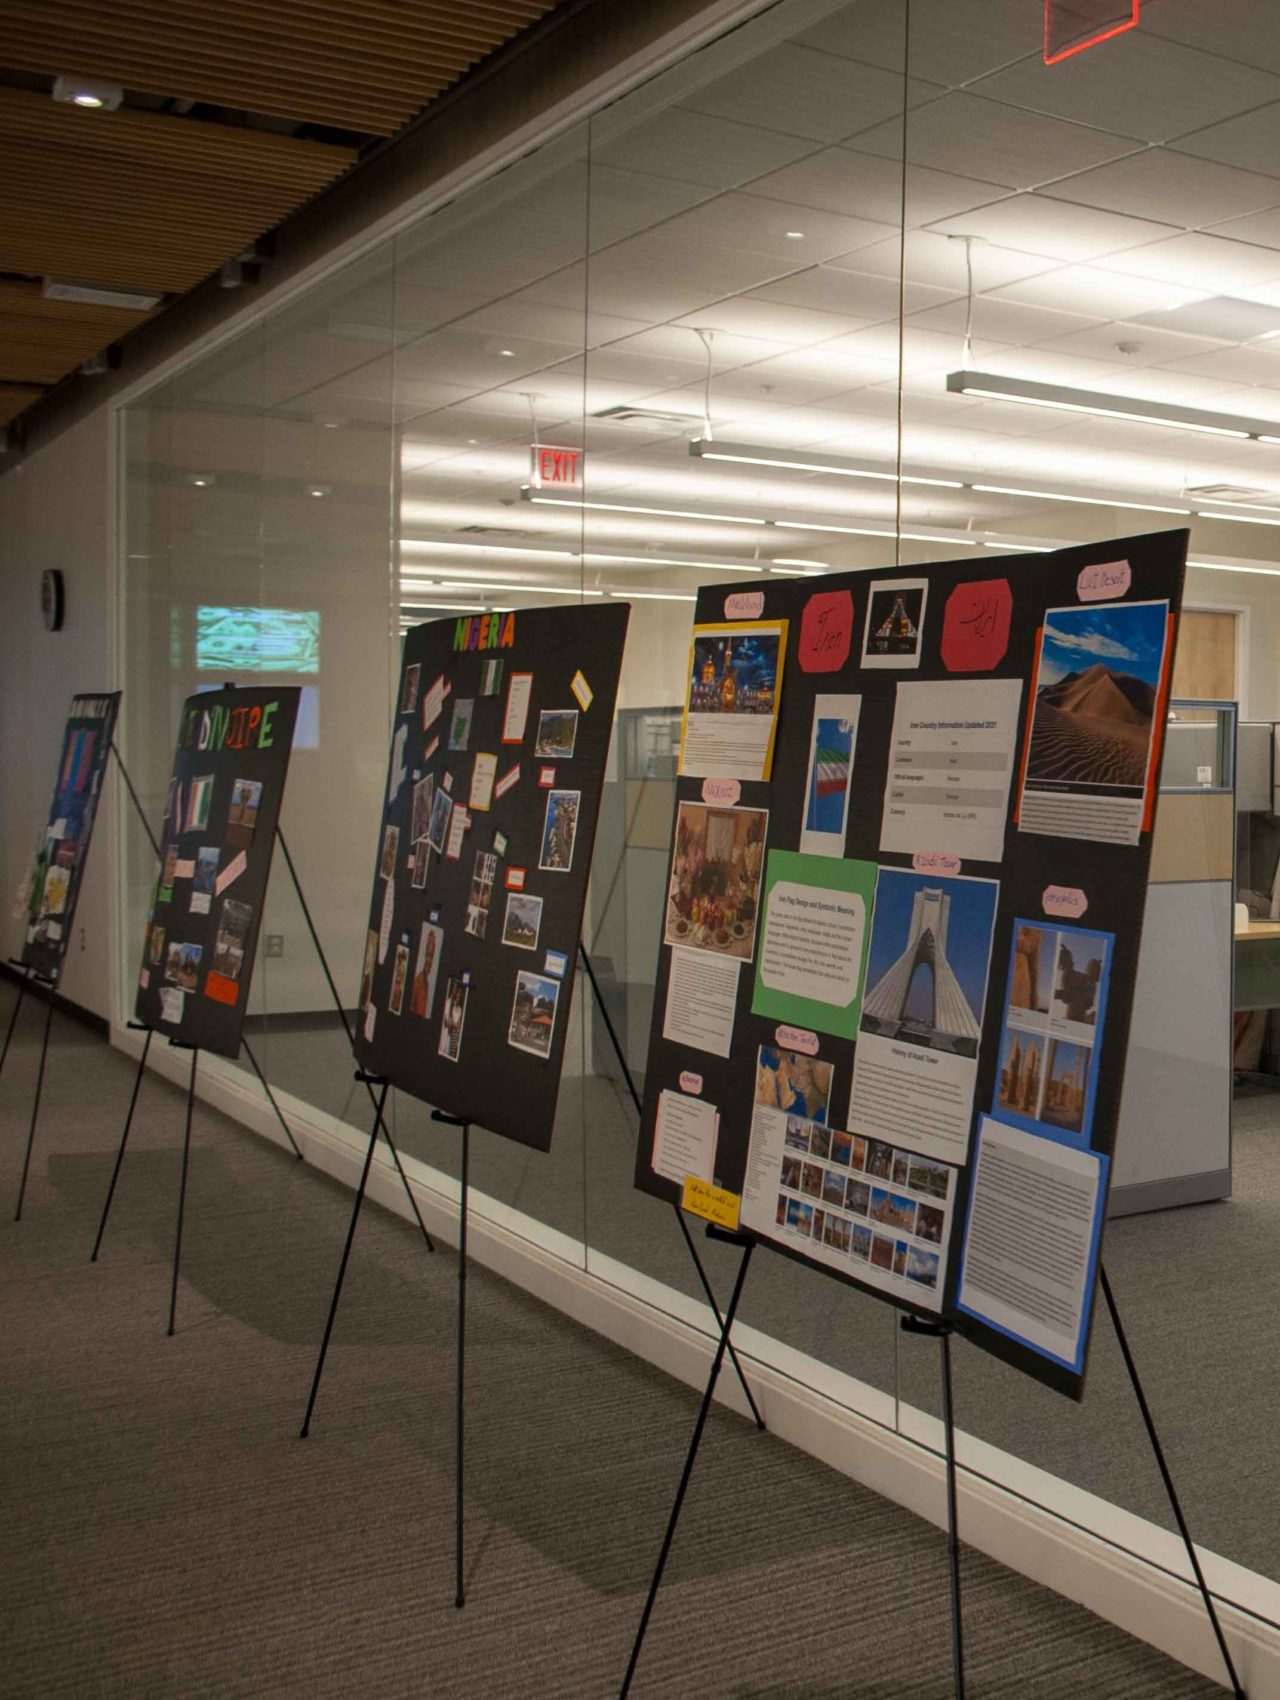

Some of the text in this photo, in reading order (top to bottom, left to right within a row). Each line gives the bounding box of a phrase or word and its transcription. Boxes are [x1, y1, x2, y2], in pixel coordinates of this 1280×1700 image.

[540, 449, 578, 483] EXIT
[453, 612, 515, 651] NIGERIA
[811, 606, 843, 652] Iran
